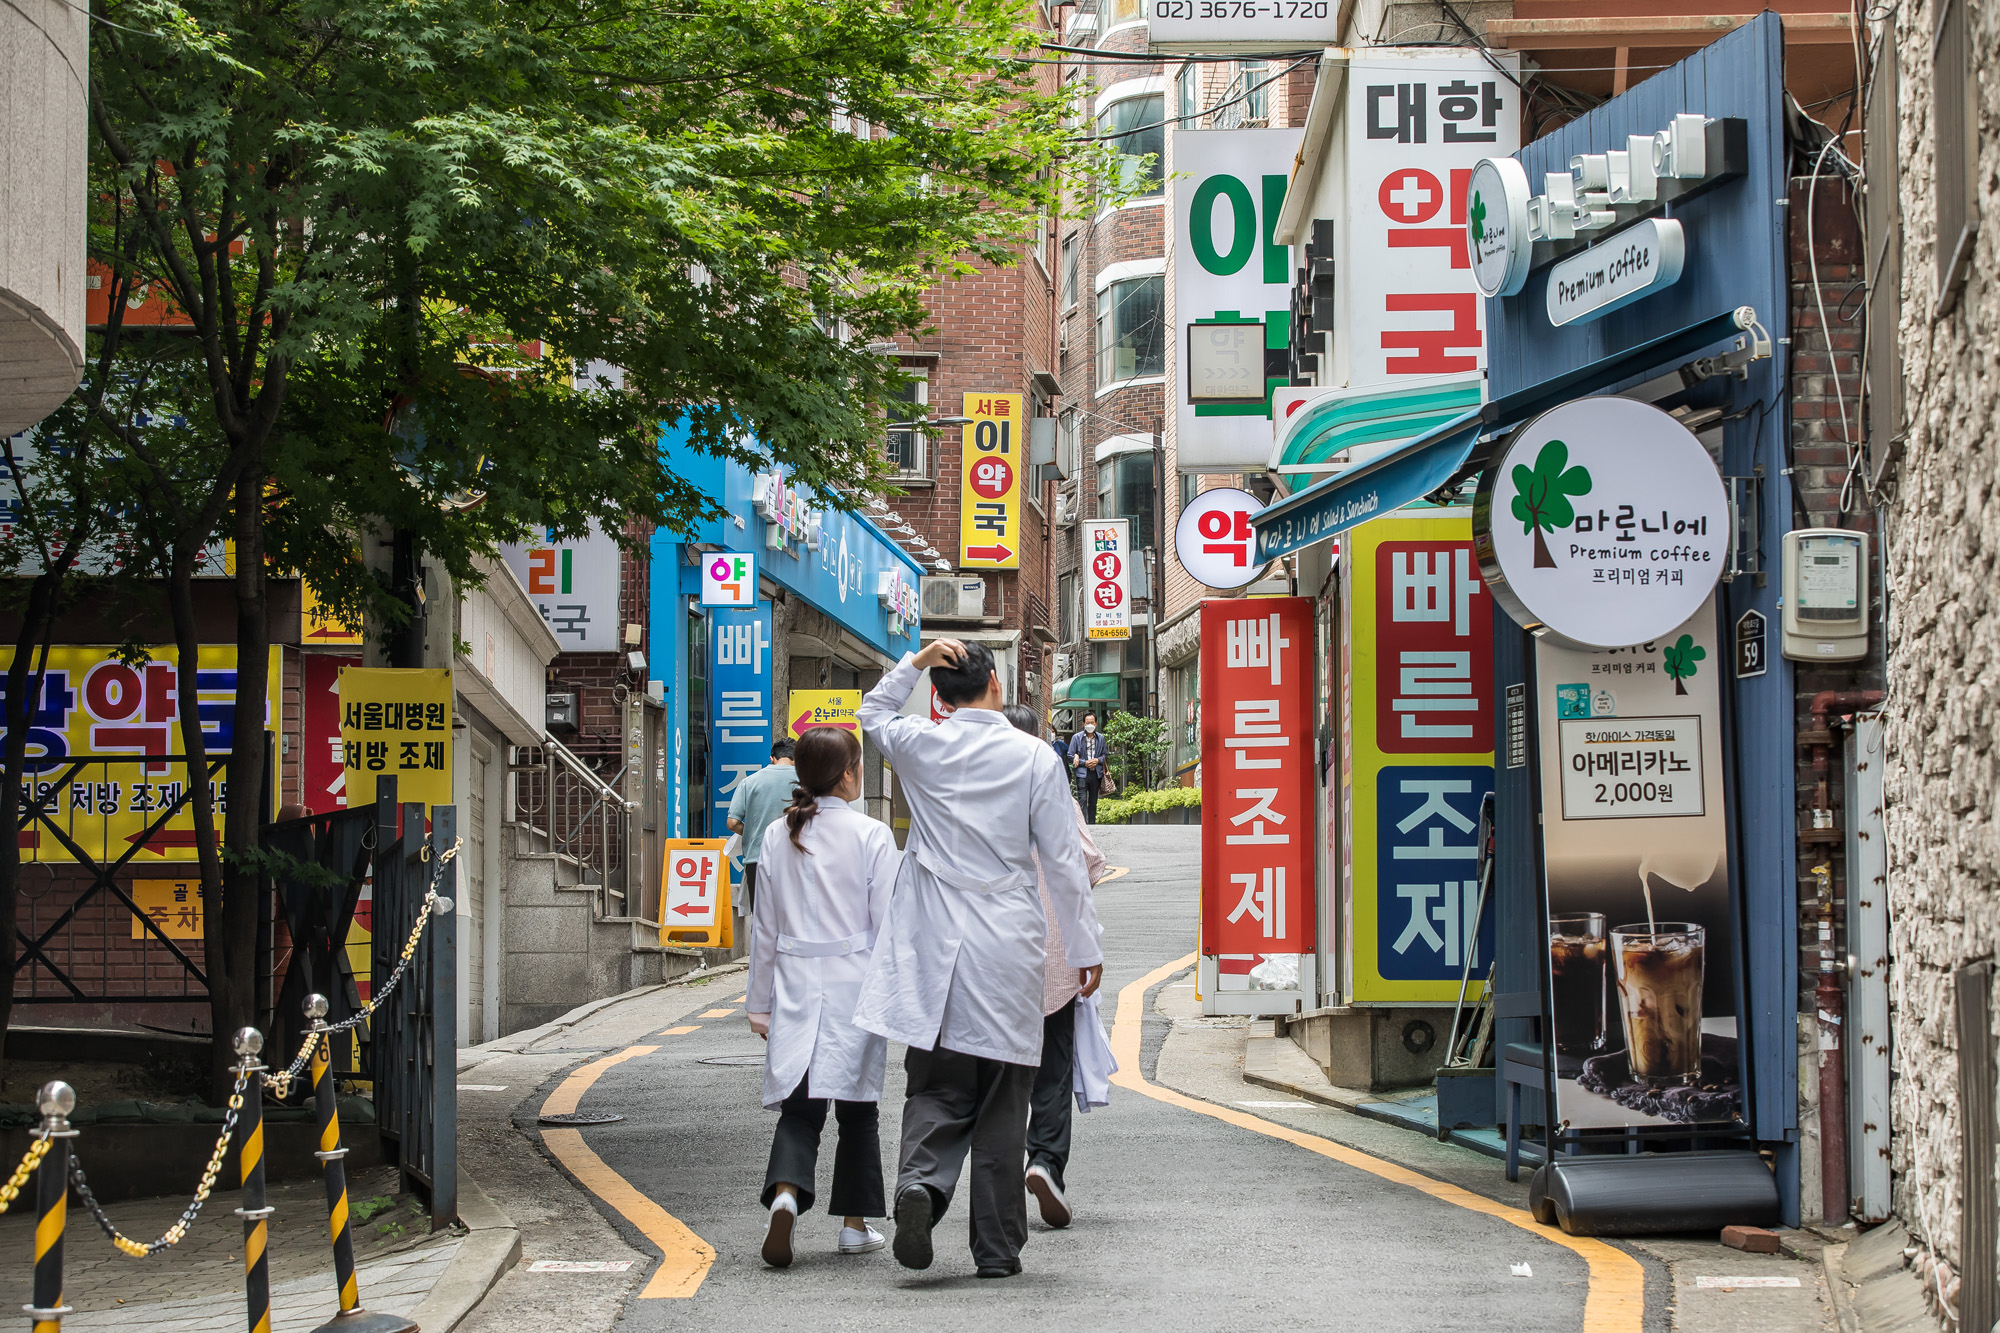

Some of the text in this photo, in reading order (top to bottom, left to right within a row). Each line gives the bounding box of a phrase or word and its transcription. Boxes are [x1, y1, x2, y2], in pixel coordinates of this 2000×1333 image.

[1155, 0, 1329, 20] 02) 3676-1720
[1366, 79, 1503, 144] 대한
[1526, 112, 1706, 242] 마로니에
[1558, 265, 1605, 319] Premium
[1210, 328, 1245, 364] 약
[975, 398, 1011, 417] 서울
[972, 419, 1011, 538] 이약국
[1268, 490, 1379, 549] 마로니에 Salad & Sandwich
[1575, 504, 1708, 542] 마로니에
[1197, 510, 1252, 567] 약
[1570, 543, 1711, 562] Premium coffee
[710, 557, 746, 601] 약
[1096, 555, 1118, 607] 냉면
[1591, 568, 1684, 586] 프리미엄 커피
[1392, 548, 1481, 739] 빠른
[1744, 641, 1758, 668] 59
[1591, 662, 1656, 675] 프리미엄 커피
[343, 702, 446, 732] 서울대병원
[814, 706, 855, 723] 온누리약국
[827, 696, 843, 706] 서울
[1585, 729, 1676, 744] 핫/아이스 가격동일
[344, 740, 446, 771] 처방 조제
[1571, 748, 1692, 778] 아메리카노
[1223, 612, 1291, 940] 빠른조제
[70, 781, 121, 815] 처방
[129, 781, 182, 815] 조제
[1594, 782, 1674, 806] 2,000원
[675, 856, 713, 898] 약
[1392, 779, 1479, 969] 조제
[319, 1042, 329, 1063] 6
